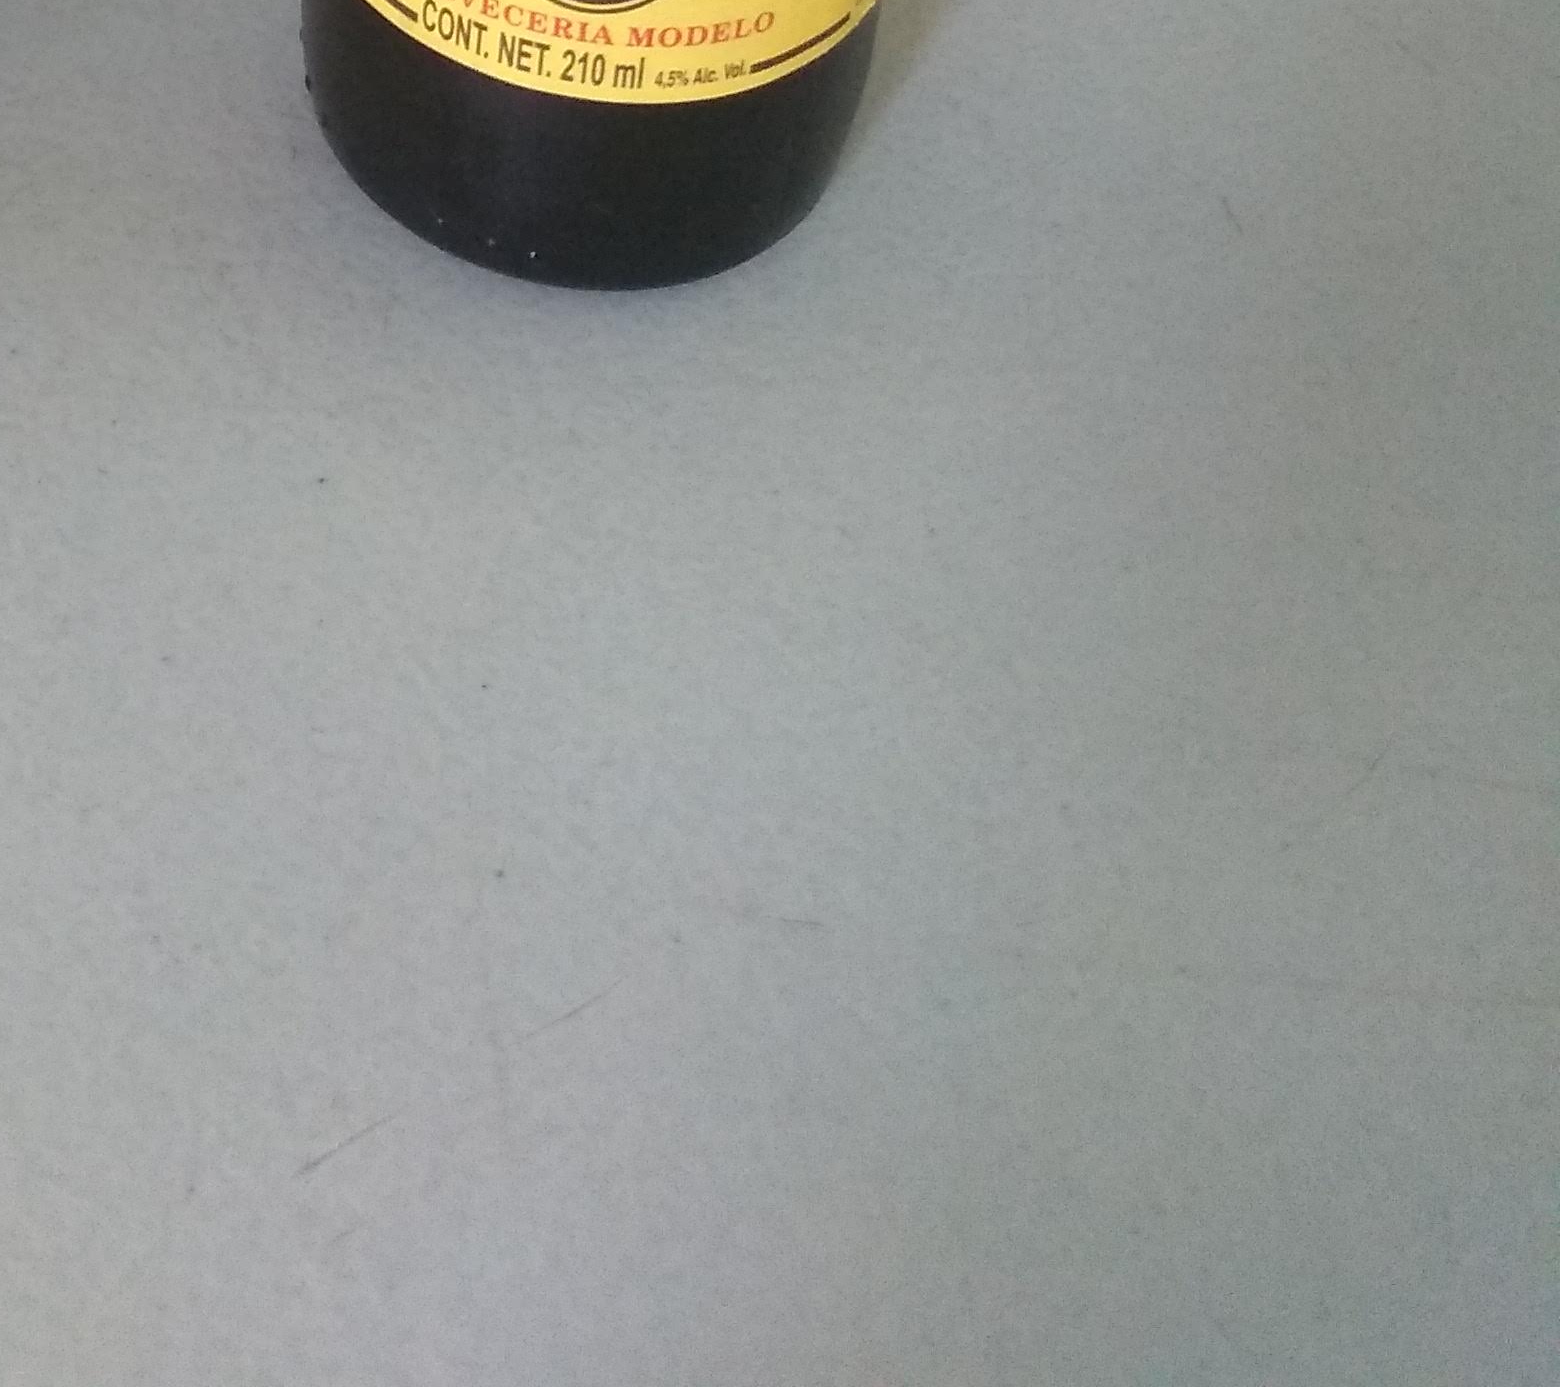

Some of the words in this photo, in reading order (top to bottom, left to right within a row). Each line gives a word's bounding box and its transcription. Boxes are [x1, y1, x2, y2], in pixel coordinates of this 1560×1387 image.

[626, 10, 775, 49] MODELO
[497, 31, 552, 77] NET.
[561, 49, 606, 87] 210
[612, 57, 646, 89] ml
